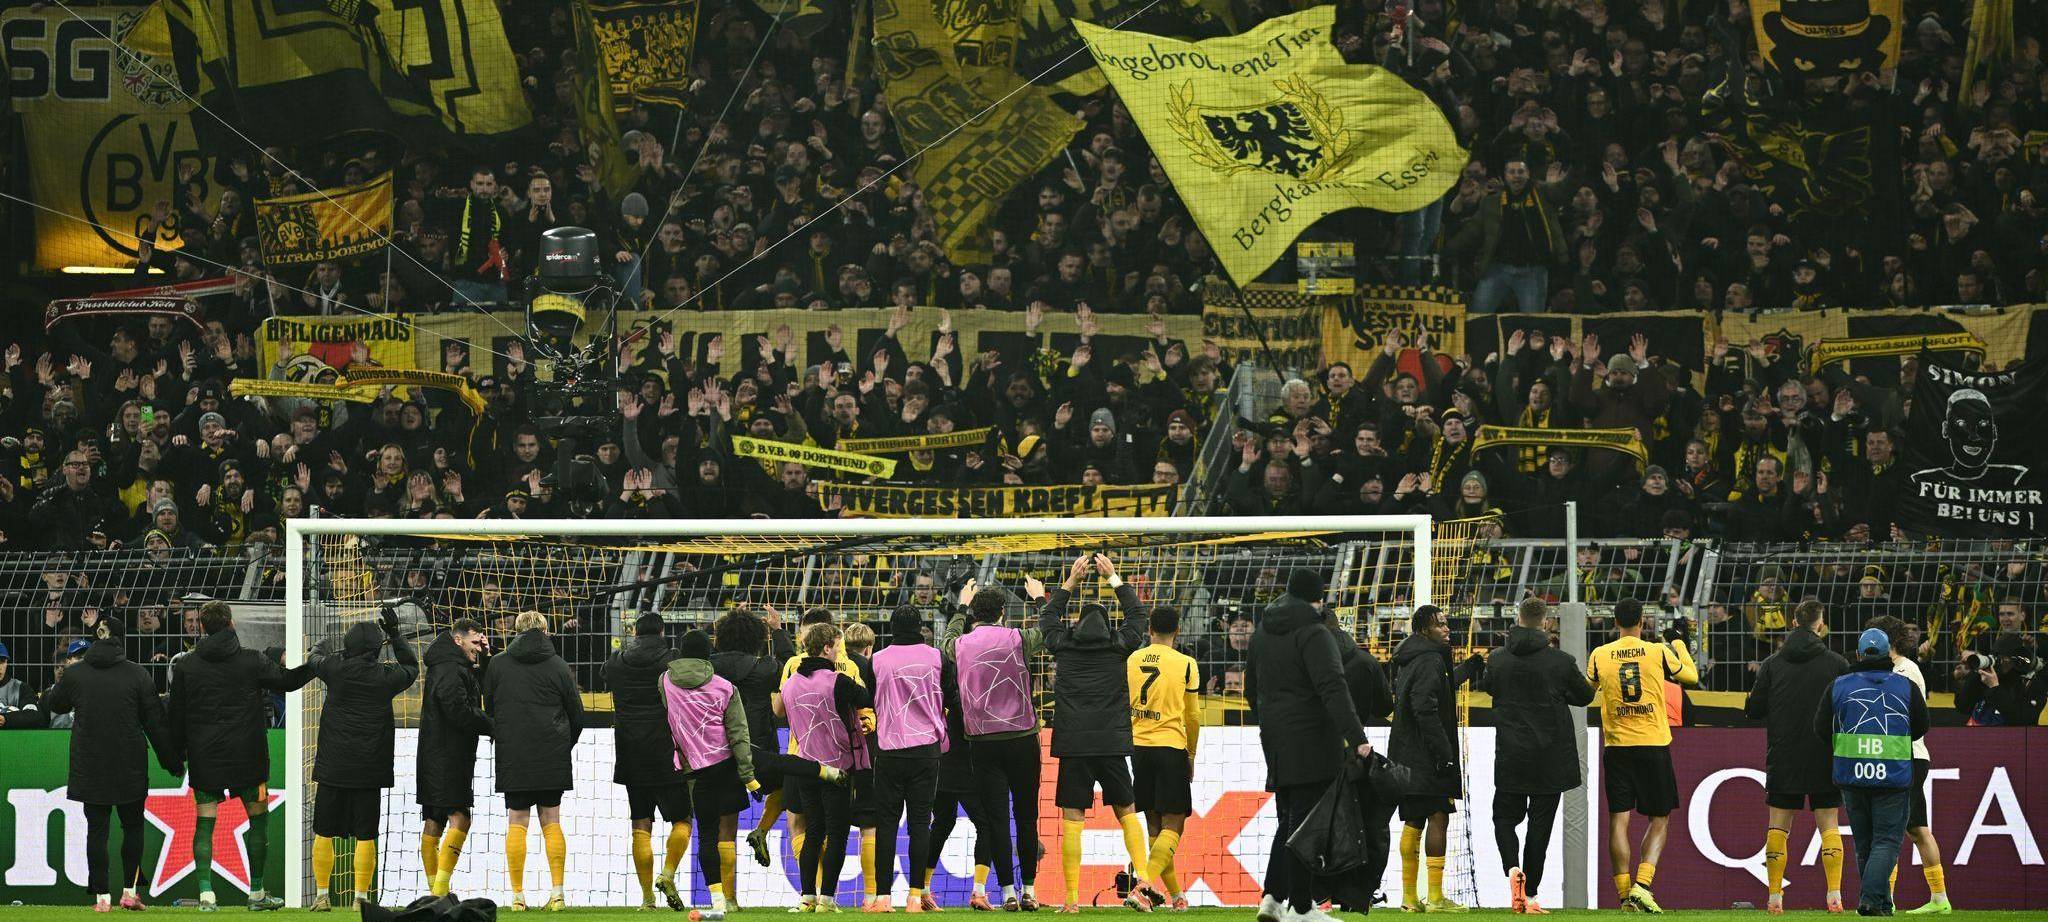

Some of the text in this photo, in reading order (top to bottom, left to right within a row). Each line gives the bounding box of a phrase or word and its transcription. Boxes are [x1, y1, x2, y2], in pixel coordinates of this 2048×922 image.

[2, 18, 111, 100] SG
[107, 121, 208, 212] BVB
[265, 250, 324, 264] ULTRAS
[1336, 295, 1456, 333] WESTFALEN
[266, 317, 411, 343] HEILIGENHAUS
[1353, 321, 1441, 350] STDIN
[1928, 364, 2017, 387] SIMON
[757, 444, 787, 457] B.V.B.
[803, 451, 867, 470] DORTMUND
[822, 486, 1004, 517] UNVERGESSEN
[1013, 485, 1097, 513] KREFT
[1919, 481, 2043, 504] FÜR IMMER
[1978, 508, 2020, 526] UNS
[1142, 654, 1160, 663] JOBE
[1611, 647, 1646, 660] F.NMECHA
[1140, 665, 1161, 705] 7
[1619, 662, 1643, 703] 8
[1616, 703, 1654, 716] DORTMUND
[1858, 737, 1884, 755] HB
[1854, 762, 1887, 780] 008
